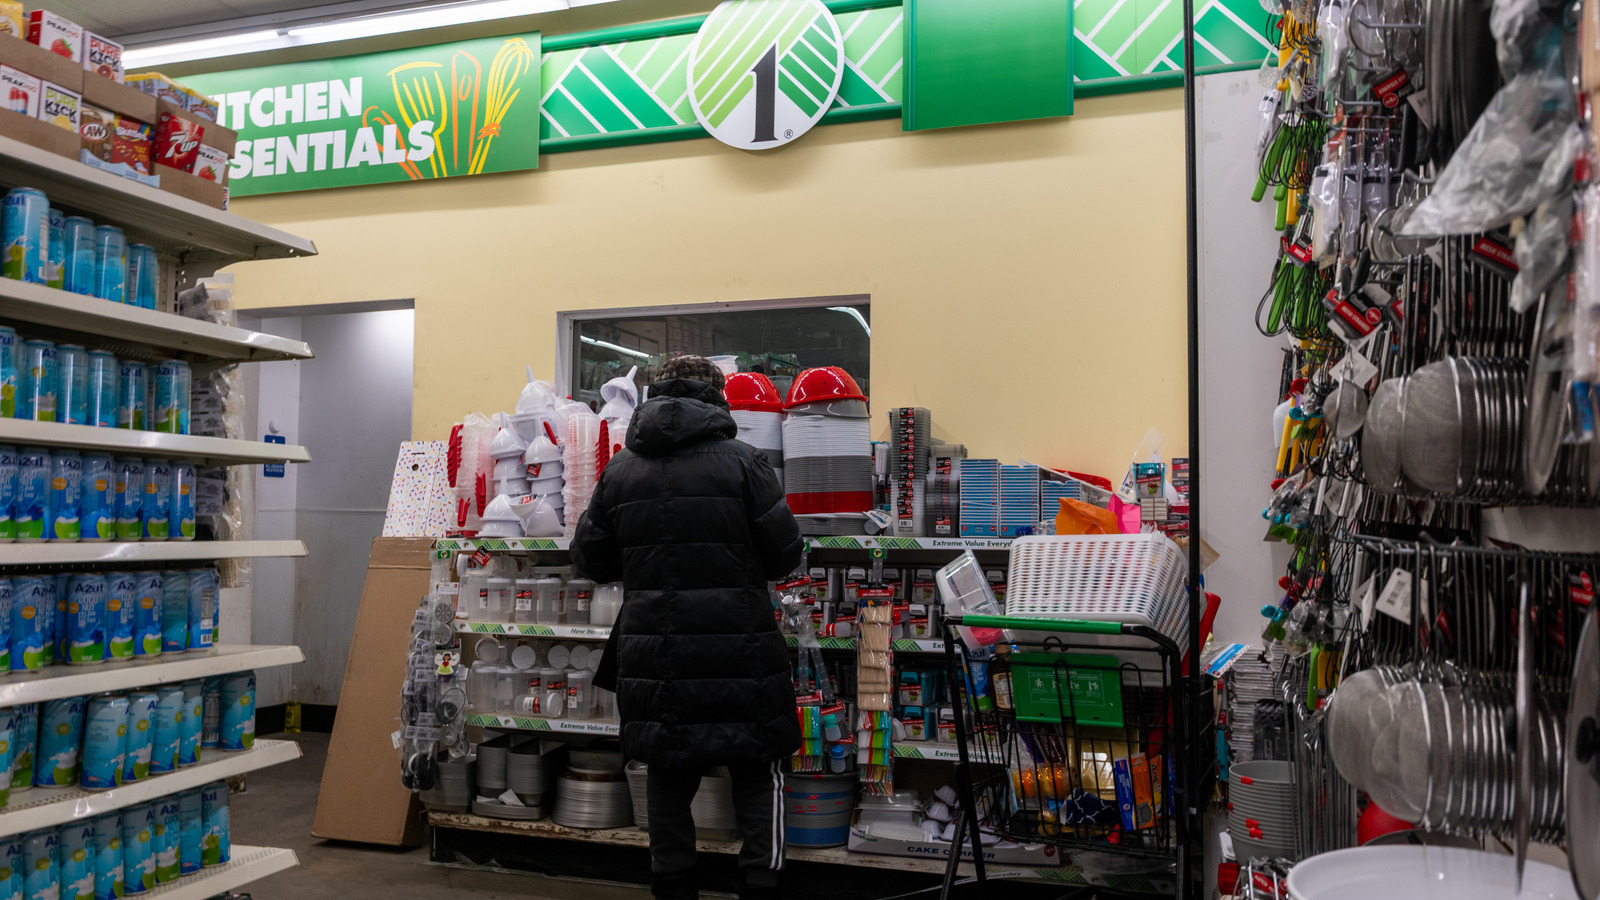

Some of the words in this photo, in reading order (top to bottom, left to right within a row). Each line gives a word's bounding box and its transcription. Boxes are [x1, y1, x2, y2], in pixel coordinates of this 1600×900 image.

[90, 38, 120, 60] PURE
[90, 49, 120, 73] KICK
[46, 88, 78, 110] PURE
[207, 77, 364, 130] ITCHEN
[751, 43, 779, 143] 1
[45, 100, 77, 124] KICK
[226, 121, 435, 180] SENTIALS
[987, 541, 1013, 549] Everyd
[75, 583, 104, 593] Azul
[560, 722, 585, 730] Extreme
[587, 723, 604, 731] Value
[605, 725, 620, 733] Ever
[935, 750, 959, 758] Extrem
[907, 846, 939, 855] CAKE
